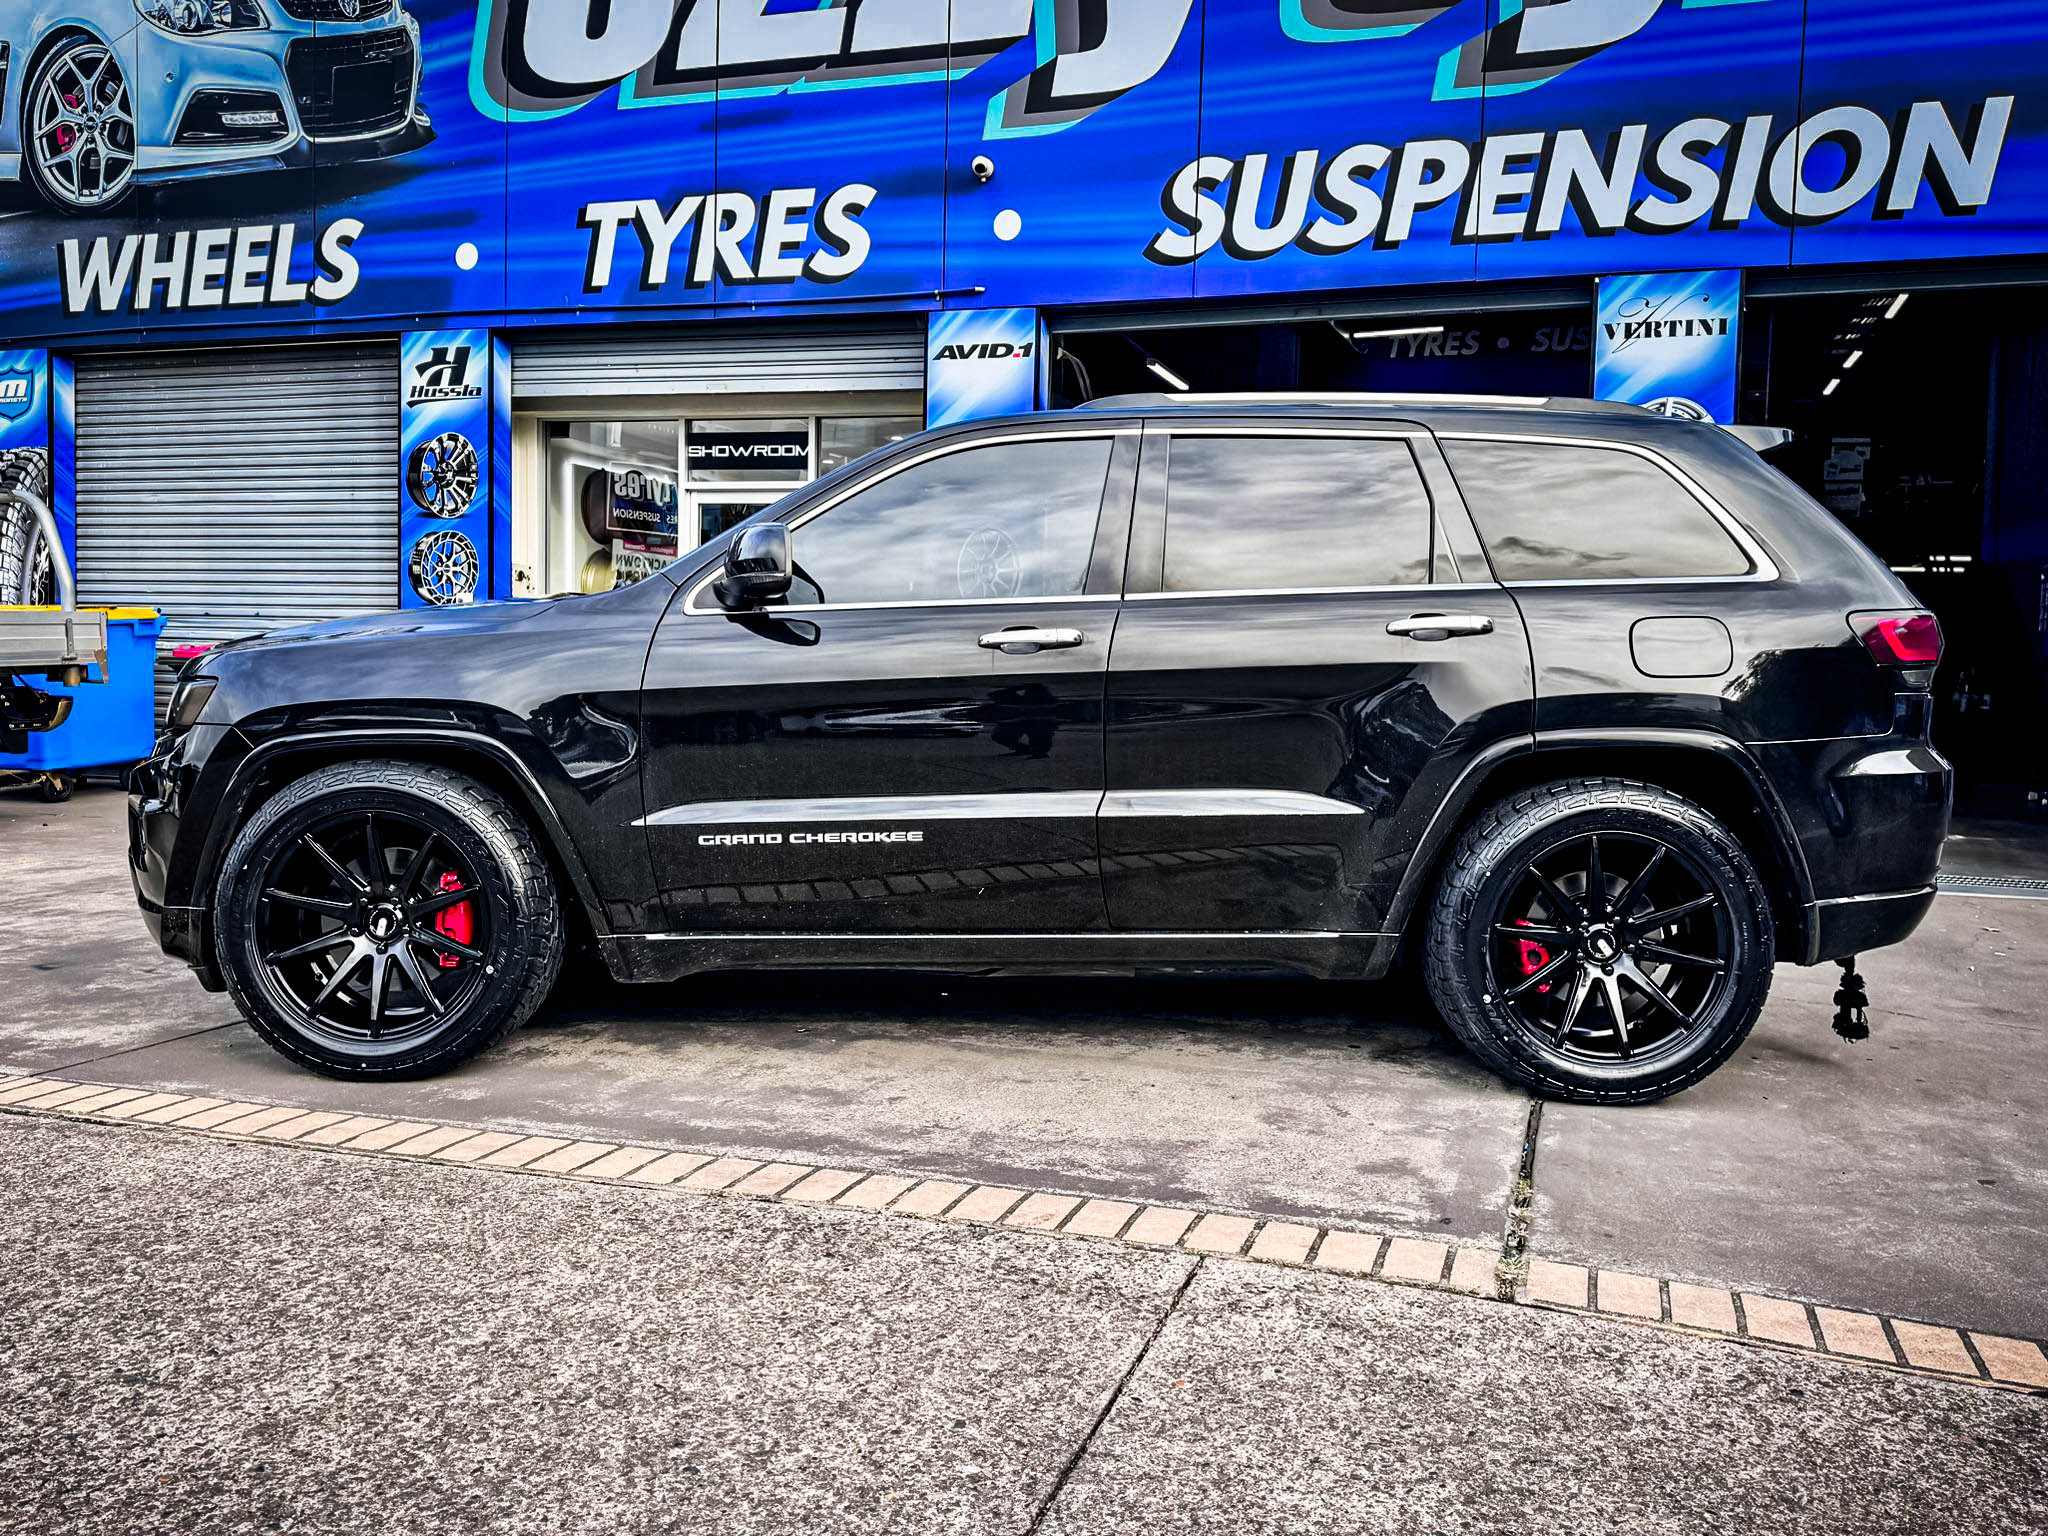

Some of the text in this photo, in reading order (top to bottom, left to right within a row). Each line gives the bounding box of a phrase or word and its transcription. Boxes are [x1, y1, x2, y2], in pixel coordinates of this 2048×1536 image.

[1152, 95, 2014, 260] SUSPENSION
[584, 183, 878, 287] TYRES
[62, 217, 366, 313] WHEELS
[1603, 317, 1729, 342] VERTINI
[932, 342, 1034, 361] AVID.1
[1389, 329, 1481, 359] TYRES
[409, 384, 482, 398] Hussla
[688, 445, 809, 457] SHOWROOM
[698, 831, 924, 846] GRAND CHEROKEE
